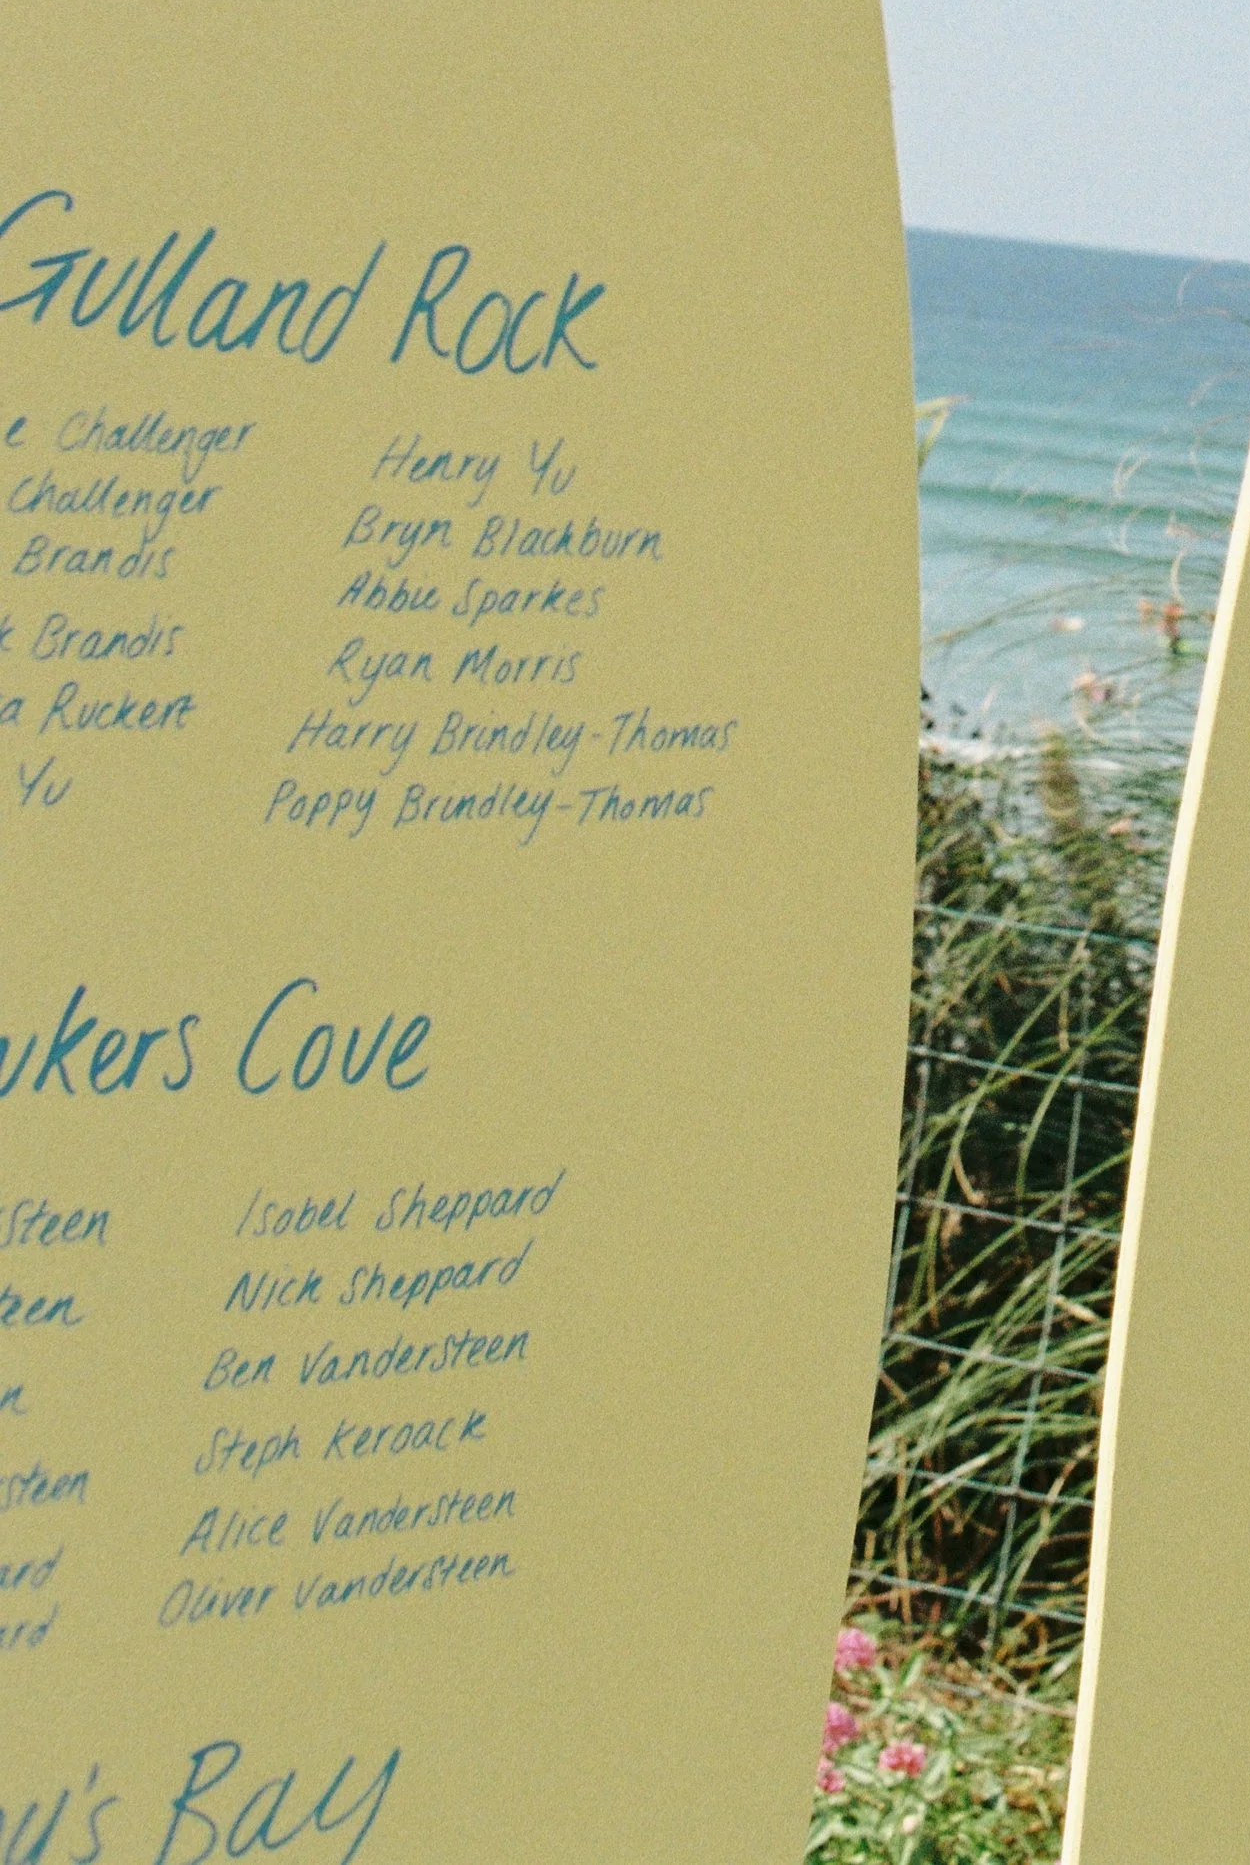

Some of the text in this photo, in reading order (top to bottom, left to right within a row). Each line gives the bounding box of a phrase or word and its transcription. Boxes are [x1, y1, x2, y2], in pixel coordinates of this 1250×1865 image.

[0, 189, 606, 375] Gulland Rock
[58, 405, 257, 485] Challenger
[371, 433, 578, 509] Henry Yu
[8, 468, 224, 543] Challenger
[341, 505, 665, 570] Bryn Blackburn
[12, 532, 176, 579] Brandis
[32, 612, 186, 662] Brandis
[452, 575, 604, 628] Sparkes
[326, 636, 584, 708] Ryan Morris
[286, 706, 740, 778] Harry Brindley-Thomas
[18, 755, 73, 807] Yu
[264, 777, 716, 848] Poppy Brindley-Thomas
[236, 977, 433, 1095] Cove
[235, 1167, 567, 1241] Isobel Sheppard
[224, 1237, 536, 1313] Nick Sheppard
[202, 1328, 531, 1392] Ben Vandersteen
[194, 1425, 301, 1479] Steph
[179, 1486, 517, 1557] Alice Vandersteen
[157, 1550, 516, 1629] Oliver Vandersteen
[153, 1738, 402, 1865] Bay
